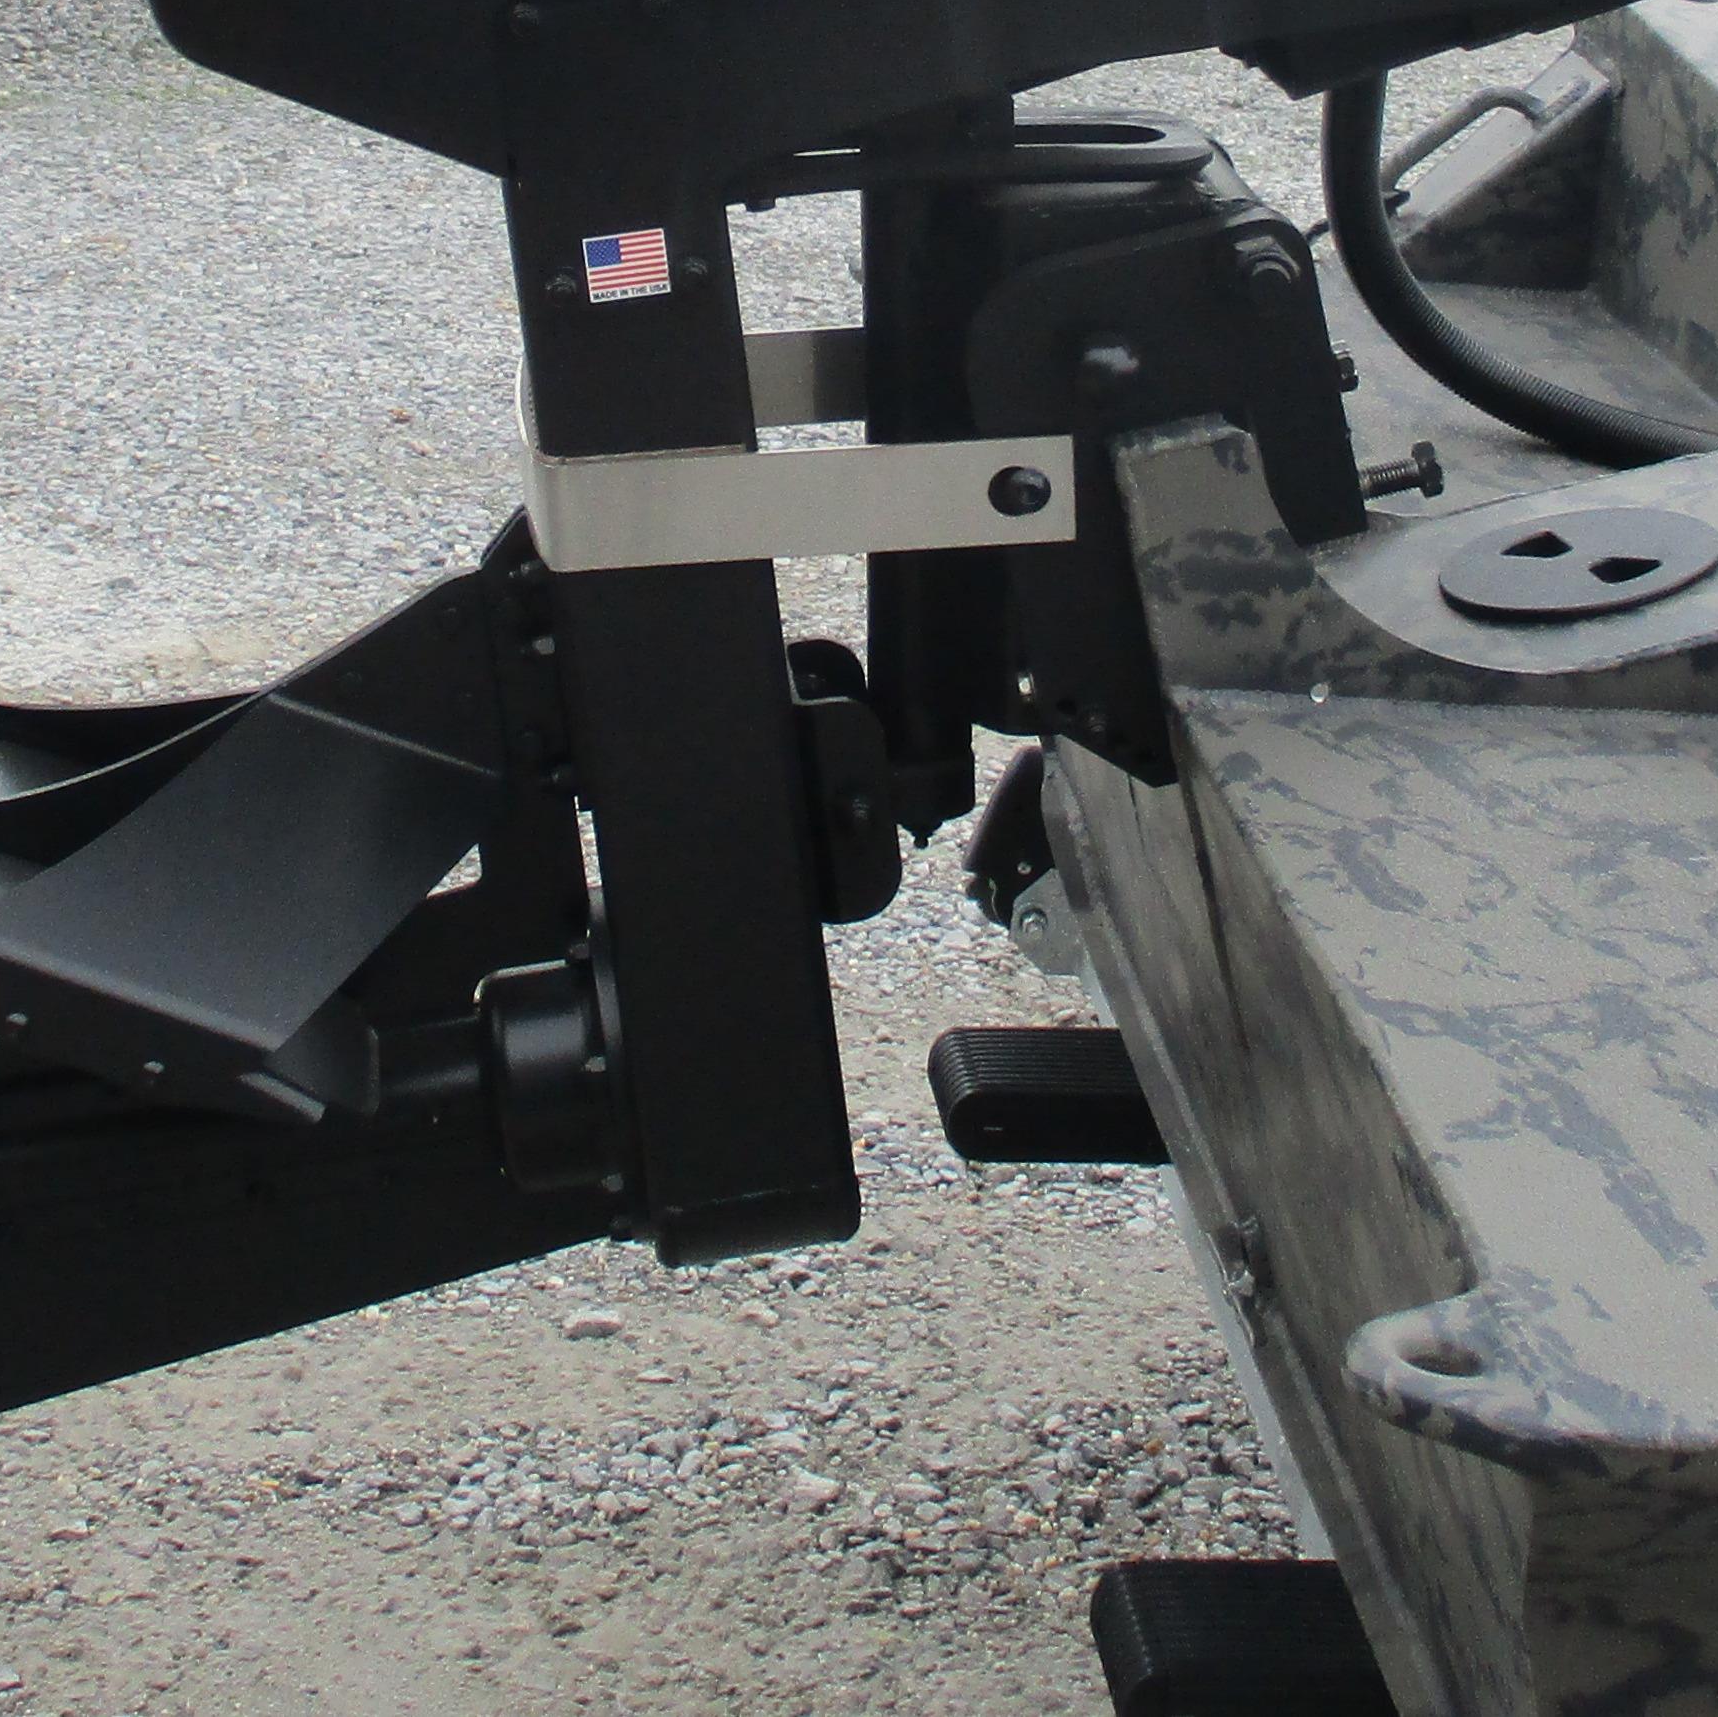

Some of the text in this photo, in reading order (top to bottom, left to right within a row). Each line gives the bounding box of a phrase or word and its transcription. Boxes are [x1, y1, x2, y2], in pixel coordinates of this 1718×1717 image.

[592, 283, 669, 300] MADE IN THE USA
